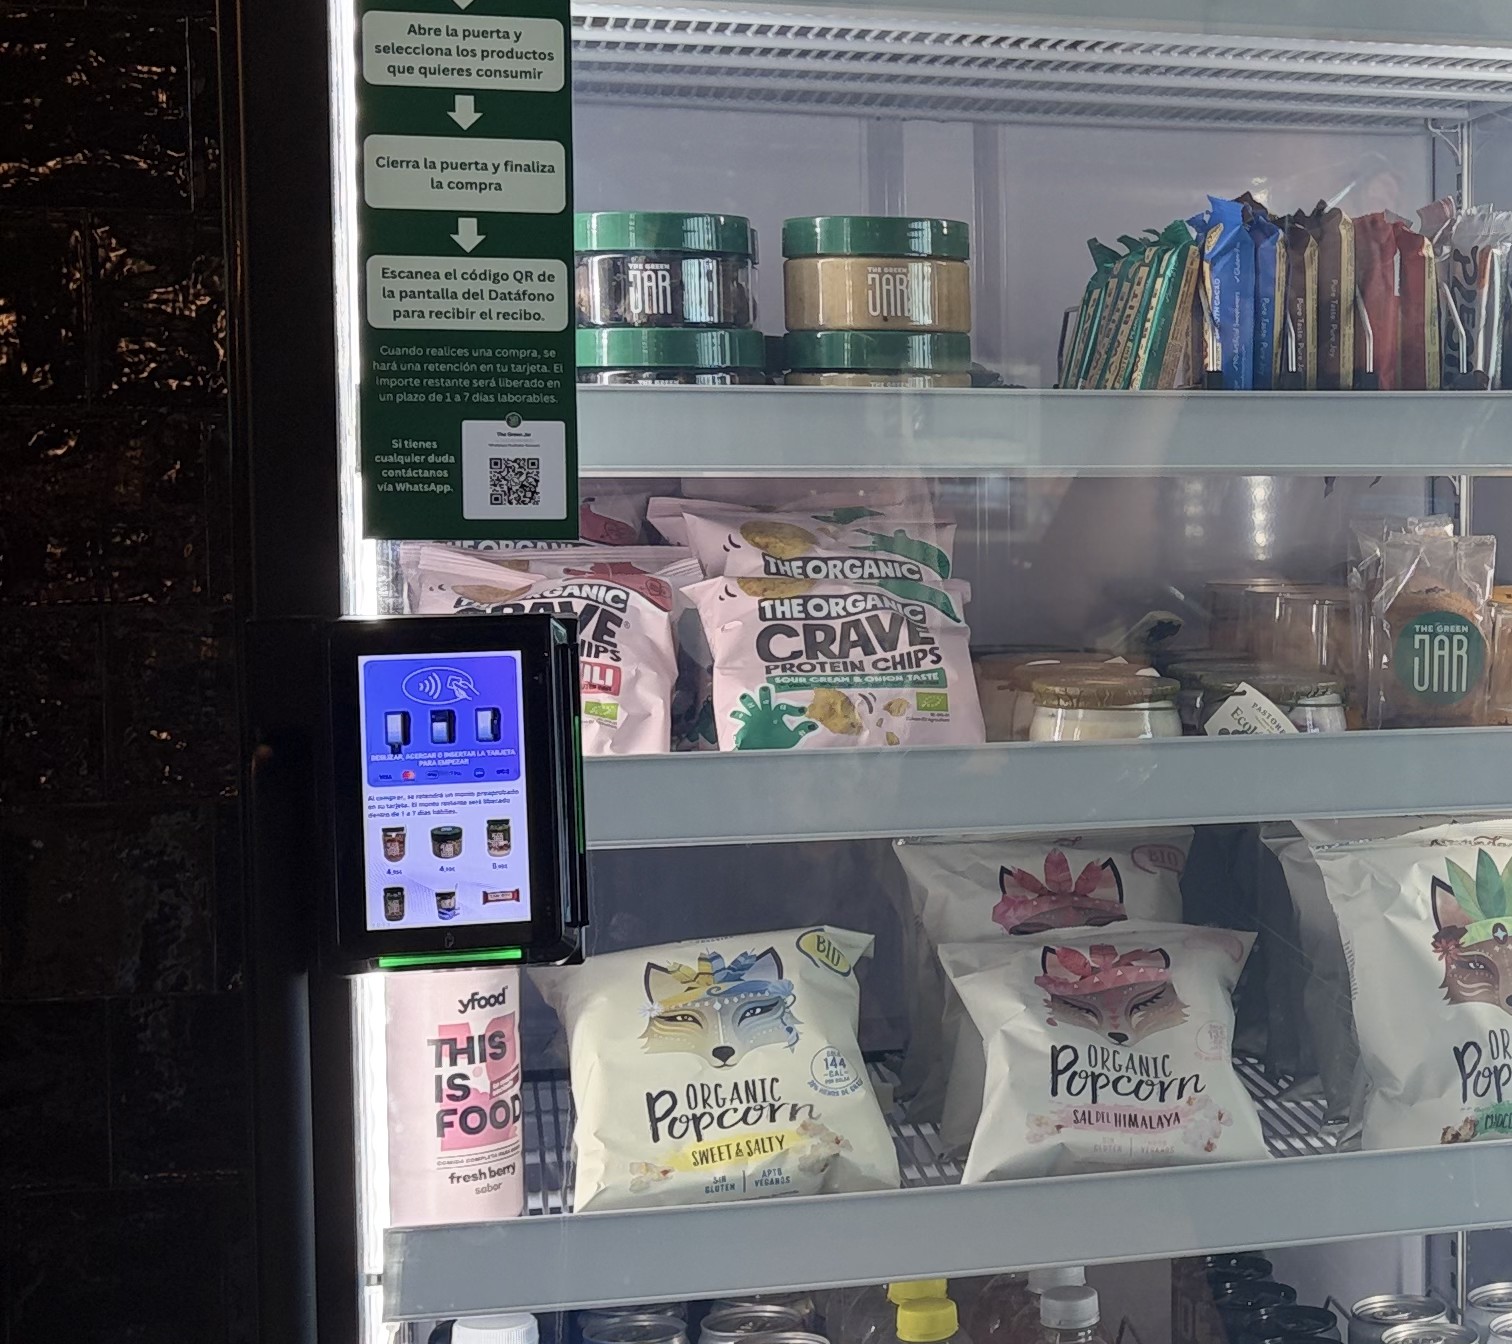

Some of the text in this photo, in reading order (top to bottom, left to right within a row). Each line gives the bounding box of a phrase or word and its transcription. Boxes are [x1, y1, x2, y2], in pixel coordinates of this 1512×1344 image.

[407, 24, 522, 43] Abre la puerta y
[375, 43, 554, 61] selecciona los productos
[387, 63, 543, 80] que quieres consumir
[375, 156, 555, 175] Cierra la puerta y finaliza
[431, 177, 502, 193] la compra
[381, 267, 555, 284] Escanea el código QR de
[382, 286, 555, 302] la pantalla del Datáfono
[628, 270, 672, 314] JAR
[867, 273, 910, 317] JAR
[393, 307, 545, 322] para recibir el recibo.
[379, 345, 556, 358] Cuando realices una compra, se
[373, 361, 564, 375] hará una retención en tu tarjeta. El
[423, 377, 560, 388] restante será liberado en
[379, 392, 558, 403] un plazo de 1 a 7 días laborables.
[391, 439, 438, 449] Si tienes
[375, 453, 455, 466] cualquier duda
[381, 468, 448, 478] contáctanos
[377, 482, 454, 493] vía WhatsApp.
[766, 556, 920, 579] THE ORGANIC
[760, 594, 924, 621] THE ORGANIC
[756, 613, 935, 663] CRAVE
[1414, 624, 1469, 633] THE GREEN
[765, 647, 942, 674] PROTEIN CHIPS
[1413, 634, 1469, 692] JAR
[906, 672, 938, 681] TASTE
[458, 987, 505, 1014] yfood
[427, 1031, 506, 1068] THIS
[823, 1057, 846, 1070] 144
[1088, 1044, 1172, 1078] ORGANIC
[1050, 1044, 1206, 1104] Popcorn
[435, 1073, 470, 1103] IS
[686, 1077, 782, 1110] ORGANIC
[436, 1094, 522, 1138] FOOD
[646, 1089, 821, 1143] Popcorn
[1073, 1109, 1181, 1130] SAL DEL HIMALAYA
[692, 1134, 785, 1167] SWEET & SALTY
[449, 1162, 516, 1184] fresh berry
[475, 1182, 503, 1194] sabor
[705, 1183, 736, 1194] GLUTEN
